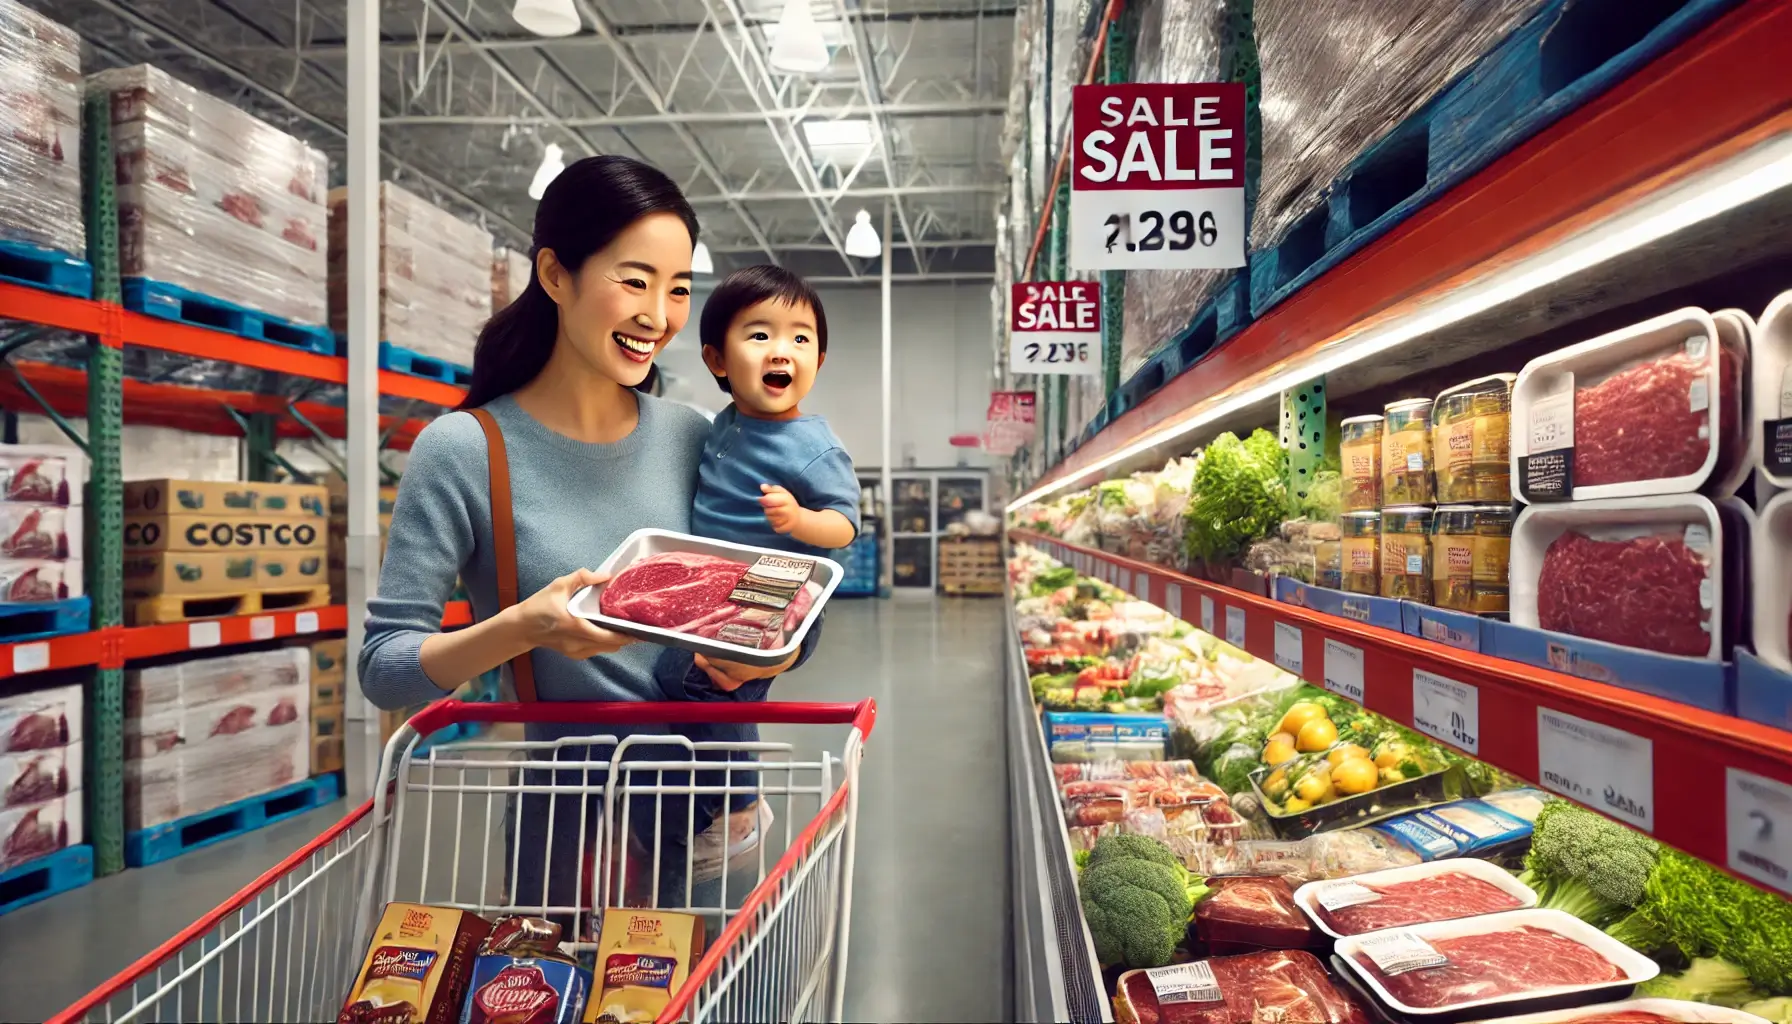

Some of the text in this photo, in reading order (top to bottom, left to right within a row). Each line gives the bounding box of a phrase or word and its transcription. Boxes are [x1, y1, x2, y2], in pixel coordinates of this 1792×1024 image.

[1100, 96, 1221, 128] SALE
[1080, 129, 1234, 183] SALE
[1018, 302, 1096, 329] SALE
[185, 522, 317, 547] COSTCO
